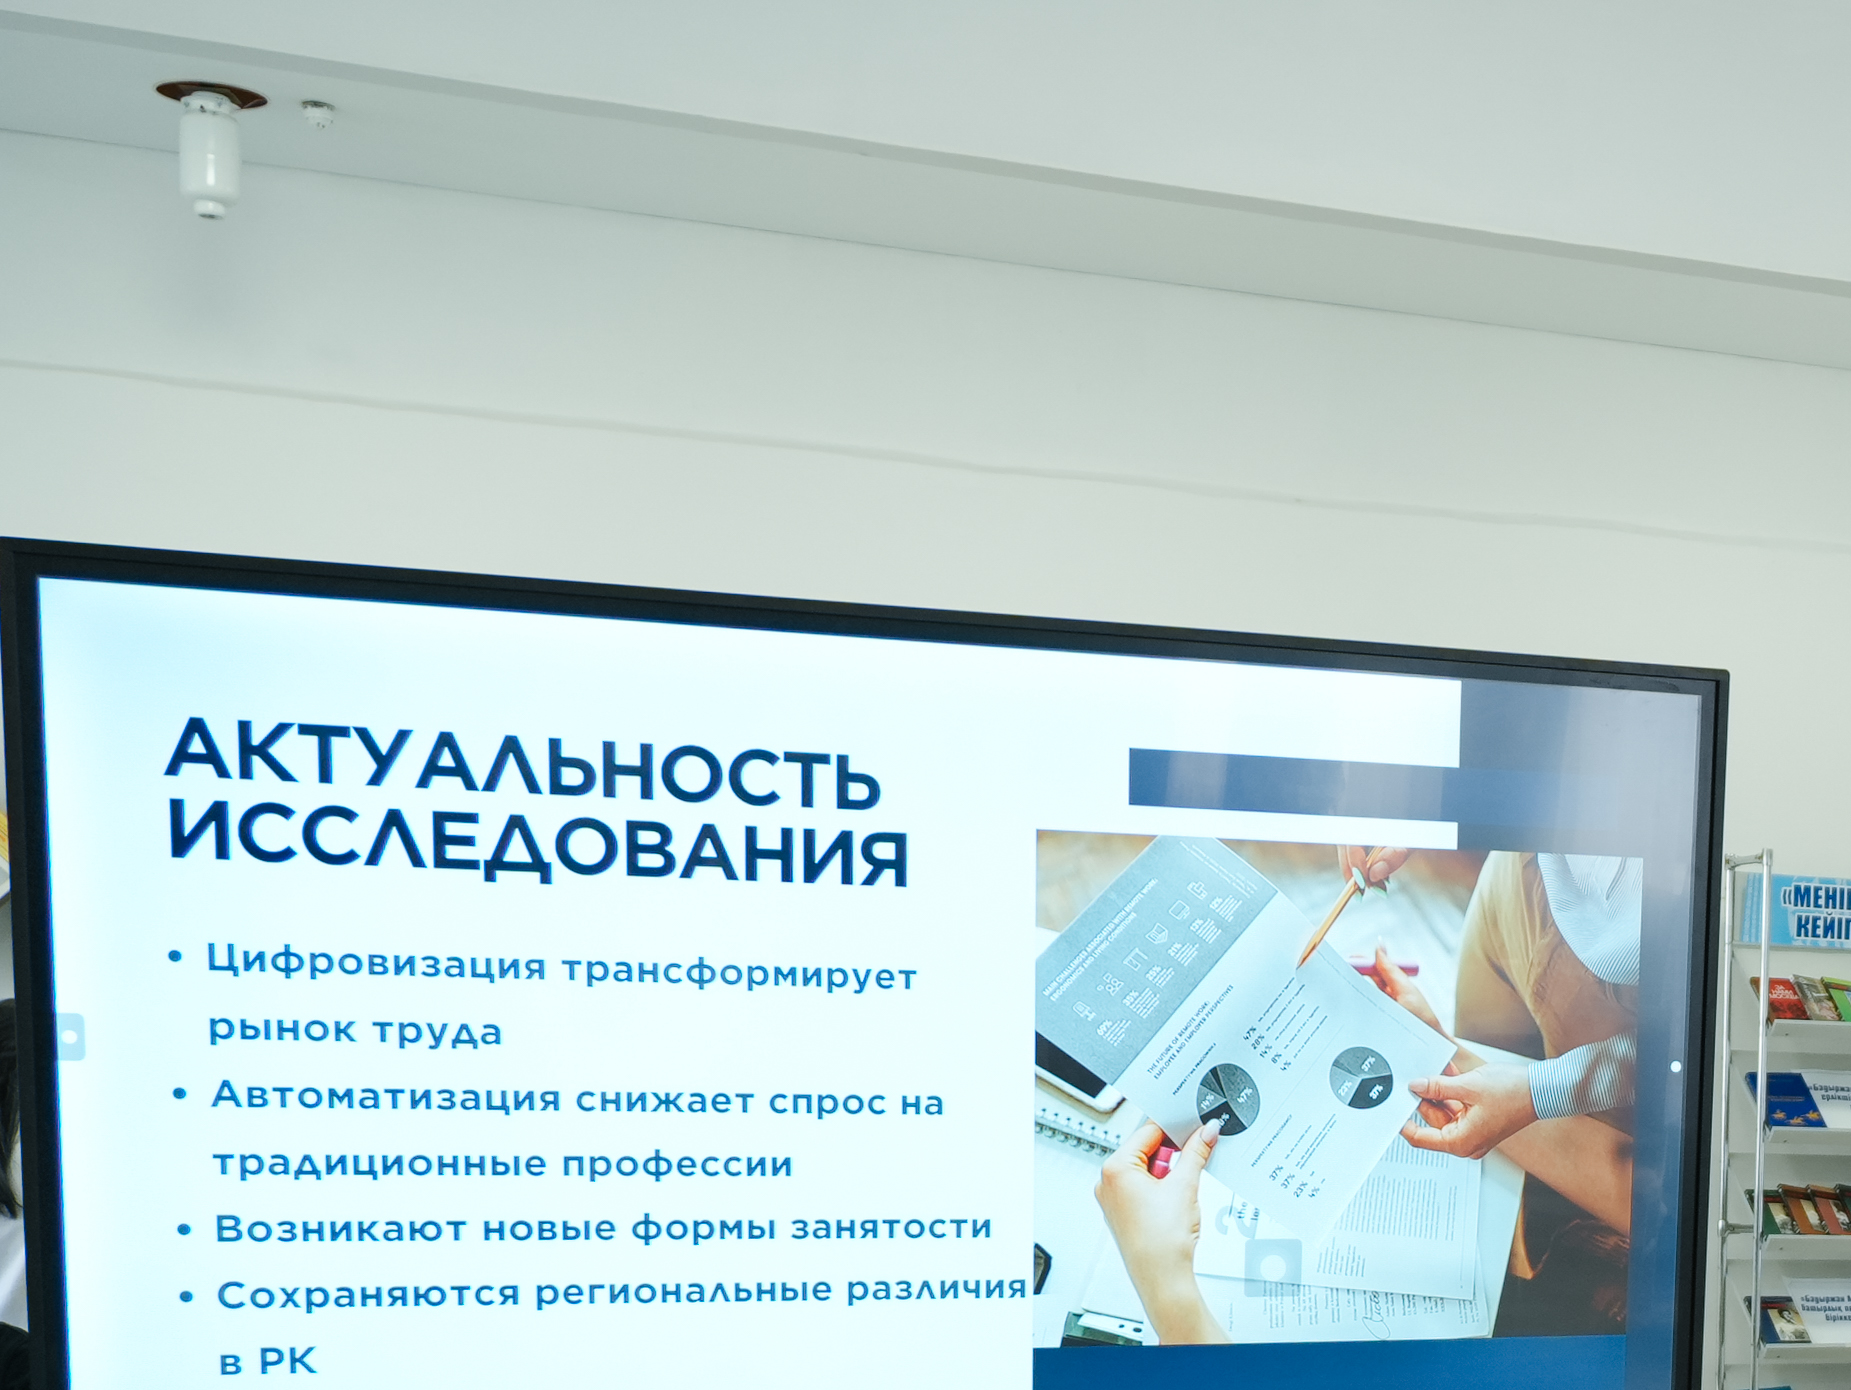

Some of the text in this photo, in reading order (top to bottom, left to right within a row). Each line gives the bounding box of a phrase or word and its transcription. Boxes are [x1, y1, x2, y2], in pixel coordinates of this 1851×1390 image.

[162, 716, 882, 811] АКТУАЛЬНОСТЬ
[168, 797, 908, 888] ИССЛЕДОВАНИЯ
[207, 942, 918, 995] Цифровизация трансформирует
[209, 1017, 502, 1050] рынок труда
[210, 1079, 944, 1120] Автоматизация снижает спрос на
[212, 1148, 792, 1183] традиционные профессии
[216, 1212, 991, 1247] Возникают новые формы занятости
[217, 1278, 1027, 1315] Сохраняются региональные различия
[219, 1346, 319, 1376] в РК
